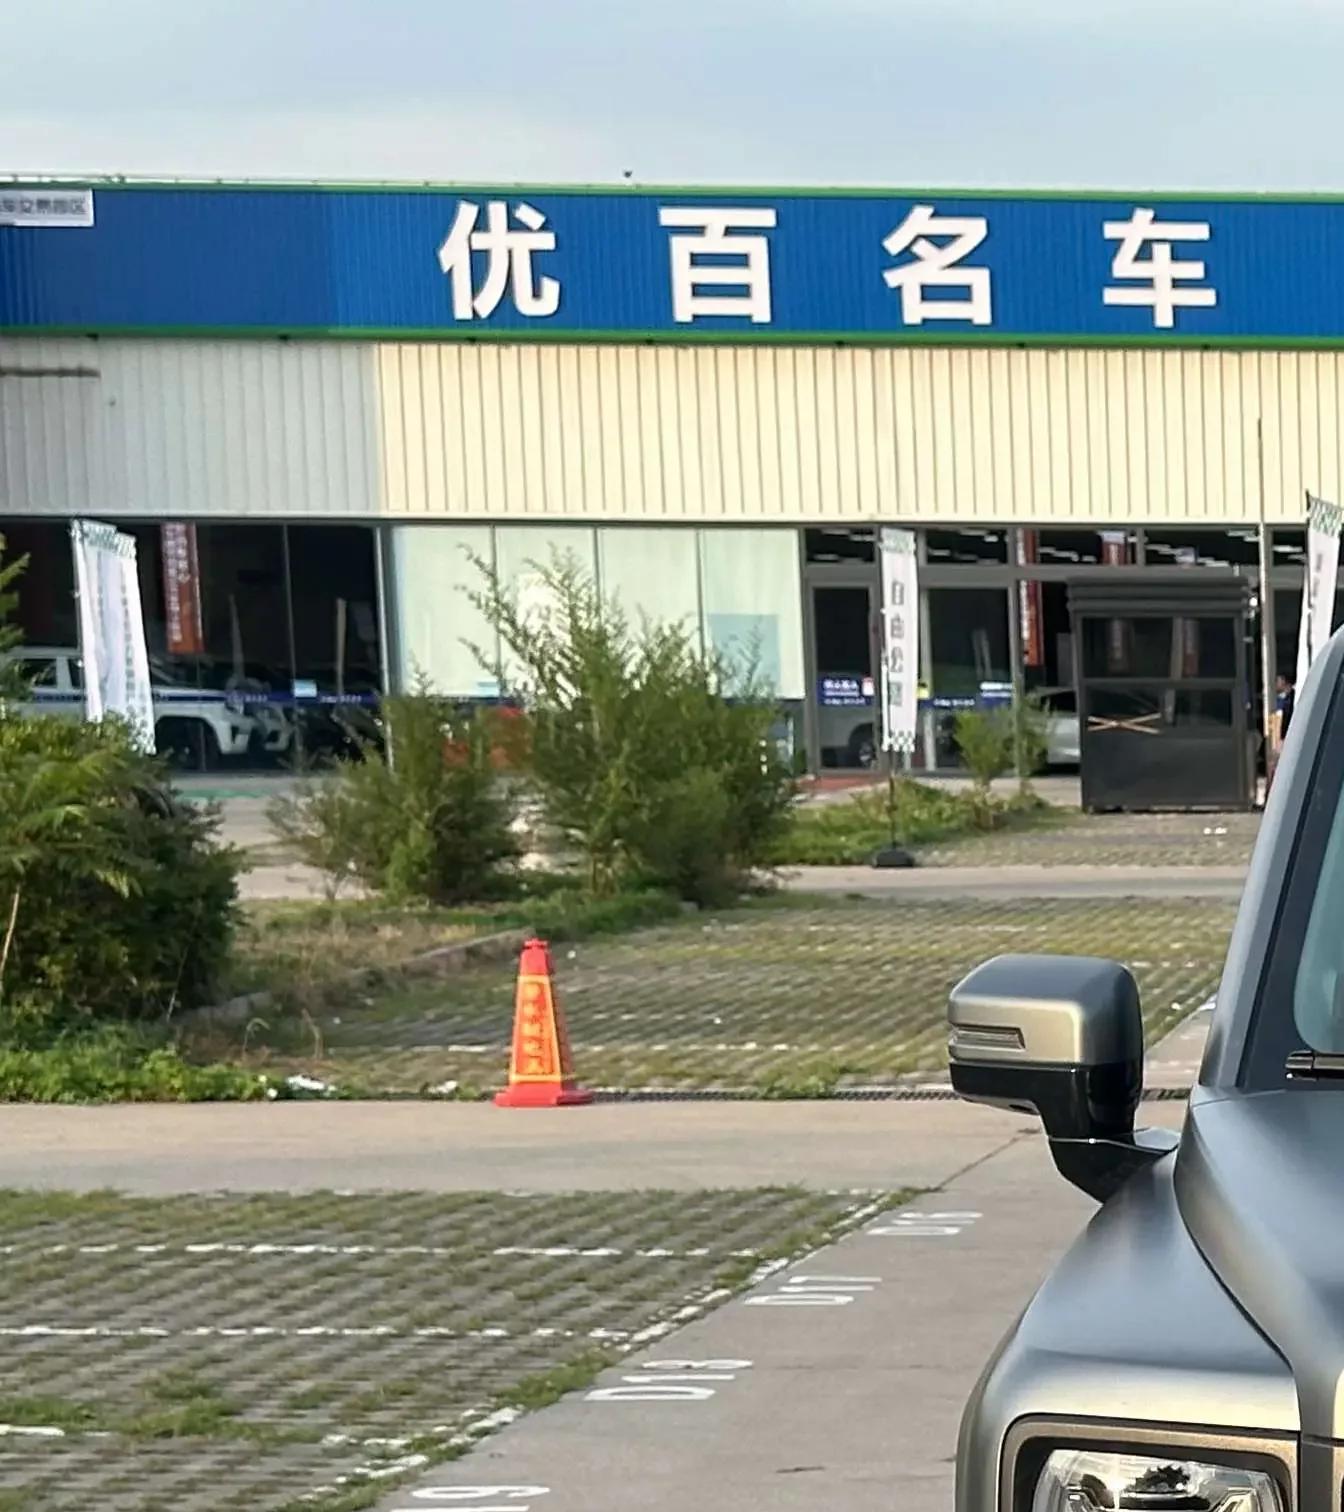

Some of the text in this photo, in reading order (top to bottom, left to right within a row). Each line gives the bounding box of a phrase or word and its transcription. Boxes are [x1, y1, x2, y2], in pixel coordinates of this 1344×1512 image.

[438, 199, 1217, 328] 优百名车
[744, 1275, 882, 1305] D17
[583, 1359, 754, 1401] D18
